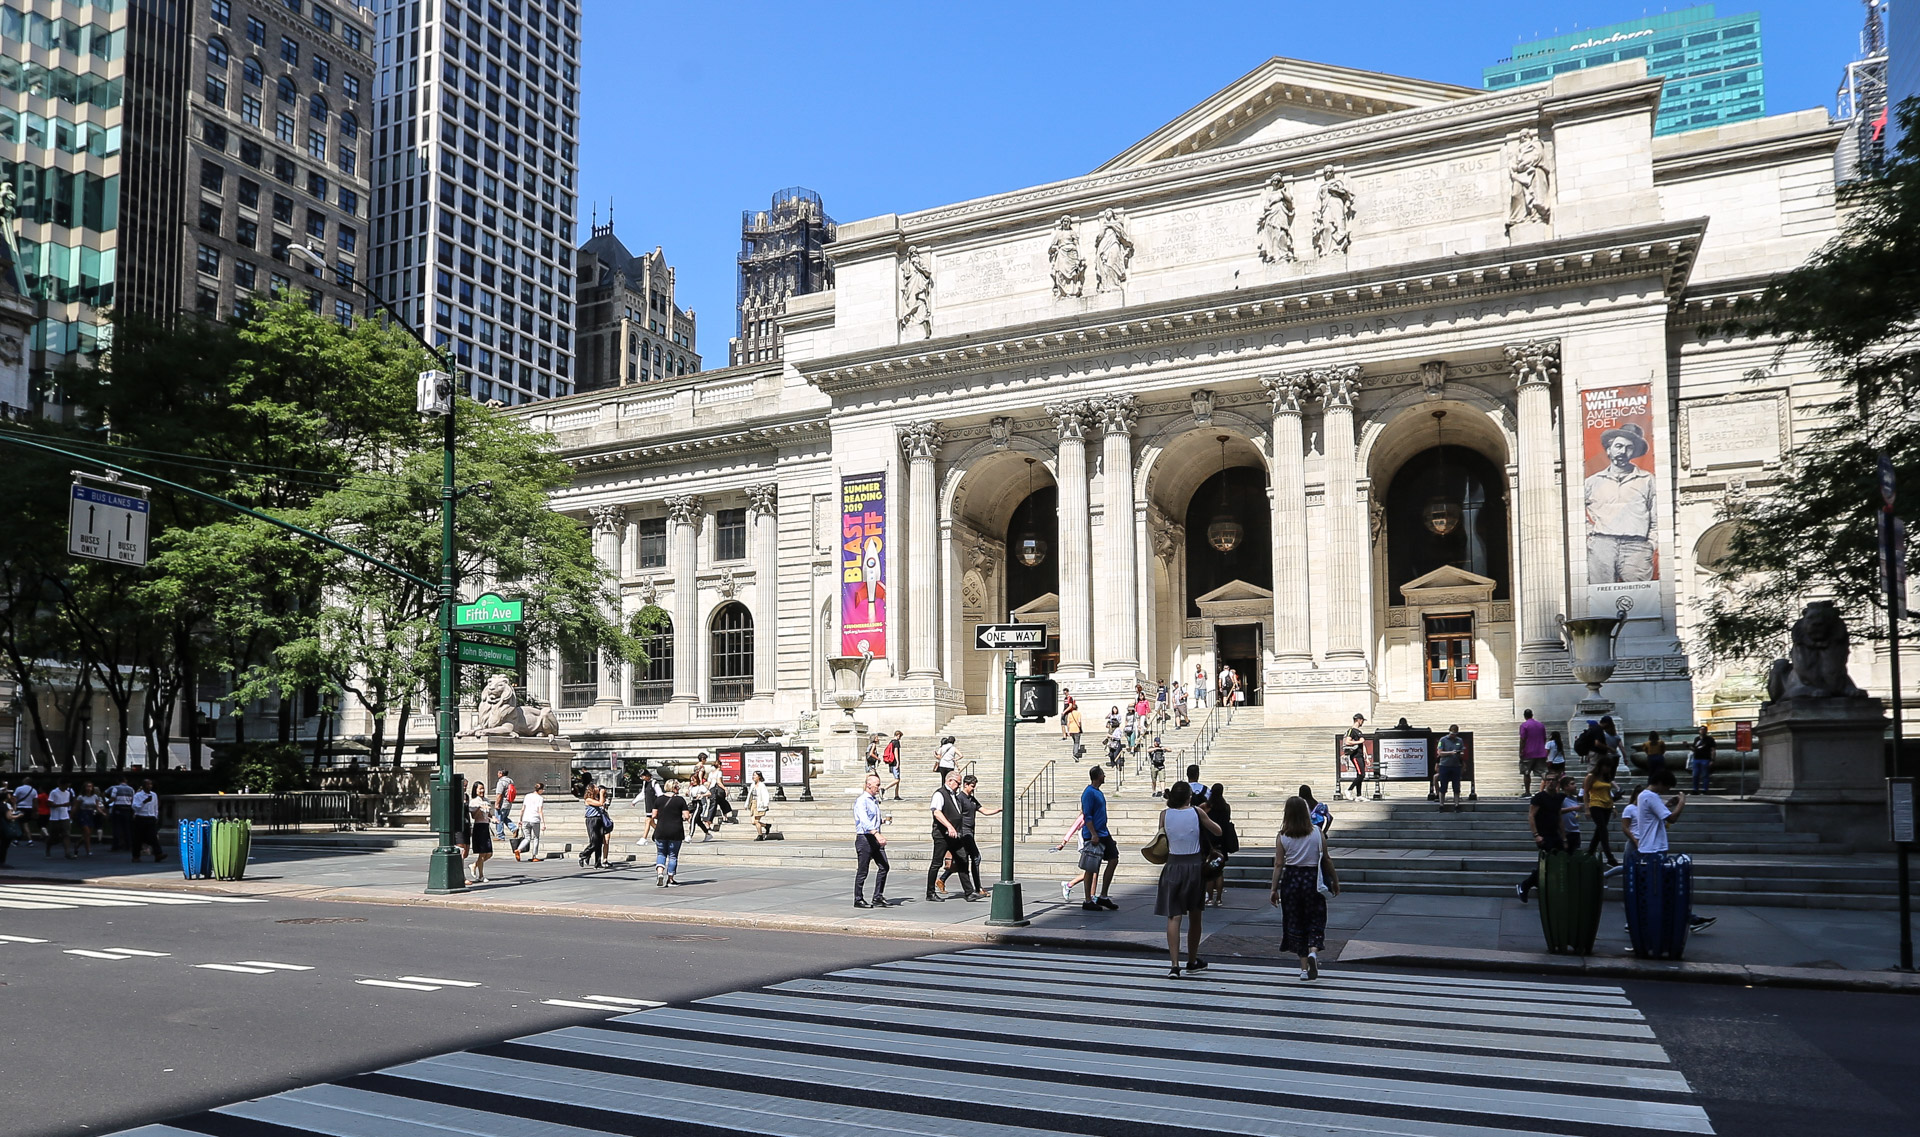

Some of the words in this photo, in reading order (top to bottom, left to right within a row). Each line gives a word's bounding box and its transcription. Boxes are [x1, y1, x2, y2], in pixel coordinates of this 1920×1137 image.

[1358, 178, 1383, 192] THE
[1393, 168, 1439, 185] TILDEN
[1450, 157, 1491, 174] TRUST
[1412, 189, 1442, 201] JONES
[1446, 183, 1480, 194] TILDEN
[1207, 201, 1254, 219] LIBRARY
[1382, 205, 1404, 214] SERVE
[1409, 201, 1424, 209] THE
[1359, 215, 1391, 226] SCIENCE
[1395, 210, 1411, 219] AND
[1163, 234, 1191, 245] JAMES
[943, 257, 961, 268] THE
[967, 250, 998, 264] ASTOR
[1003, 240, 1045, 257] LIBRARY
[1152, 242, 1189, 254] DEDICATED
[1136, 252, 1178, 264] LITERATURE
[1176, 252, 1216, 264] MDCCCXX
[955, 273, 976, 283] JOHN
[979, 268, 1004, 278] JACOB
[1008, 262, 1031, 273] ASTOR
[1012, 367, 1050, 382] THE
[1066, 358, 1115, 374] NEW
[1134, 348, 1187, 365] YORK
[1208, 334, 1284, 355] PUBLIC
[1306, 318, 1404, 342] LIBRARY
[1585, 390, 1618, 402] WALT
[1586, 396, 1648, 410] WHITMAN
[1586, 405, 1646, 420] AMERICA'S
[1587, 418, 1618, 428] POET
[844, 483, 880, 494] SUMMER
[92, 492, 106, 503] BUS
[108, 496, 131, 507] LANES
[844, 492, 882, 504] READING
[844, 503, 863, 512] 2019
[864, 512, 882, 554] OFF
[80, 534, 100, 545] BUSES
[81, 545, 98, 554] ONLY
[118, 542, 136, 552] BUSES
[844, 514, 862, 583] BLAST
[119, 552, 134, 561] ONLY
[466, 608, 488, 621] Fifth
[492, 608, 512, 620] Ave
[986, 632, 1006, 642] ONE
[1016, 632, 1037, 640] WAY
[463, 646, 477, 656] John
[478, 648, 502, 660] Bigelow
[1402, 753, 1424, 761] Library
